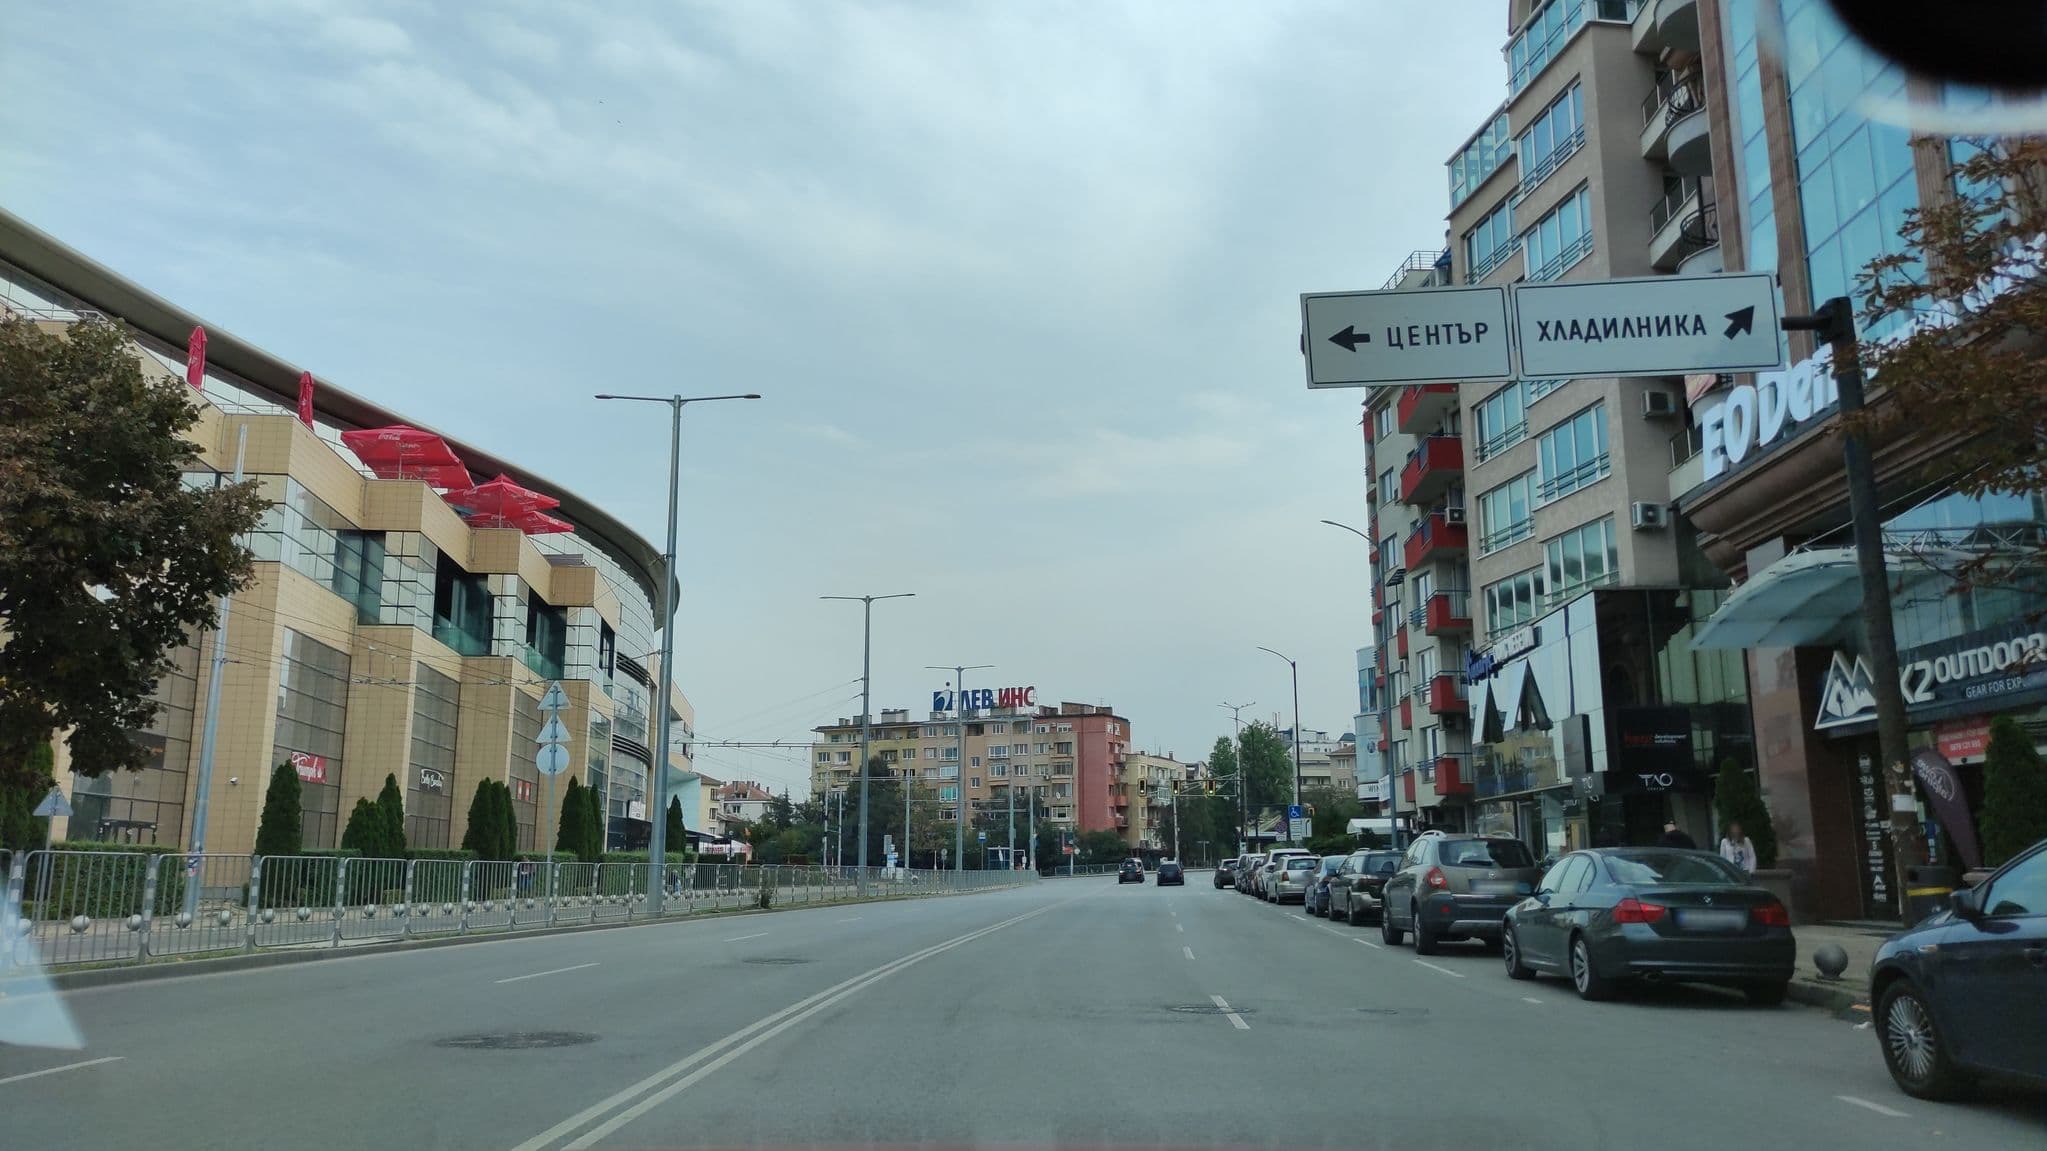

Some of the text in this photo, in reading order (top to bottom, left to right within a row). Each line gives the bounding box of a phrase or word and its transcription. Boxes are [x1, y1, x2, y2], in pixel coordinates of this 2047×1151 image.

[1387, 322, 1488, 348] ЦЕНТЪР
[1537, 314, 1707, 343] ХЛАДИЛНИКА
[960, 686, 1035, 711] ЛЕВ ИНС
[1965, 685, 1986, 699] GEAR
[1988, 681, 2006, 695] FOR
